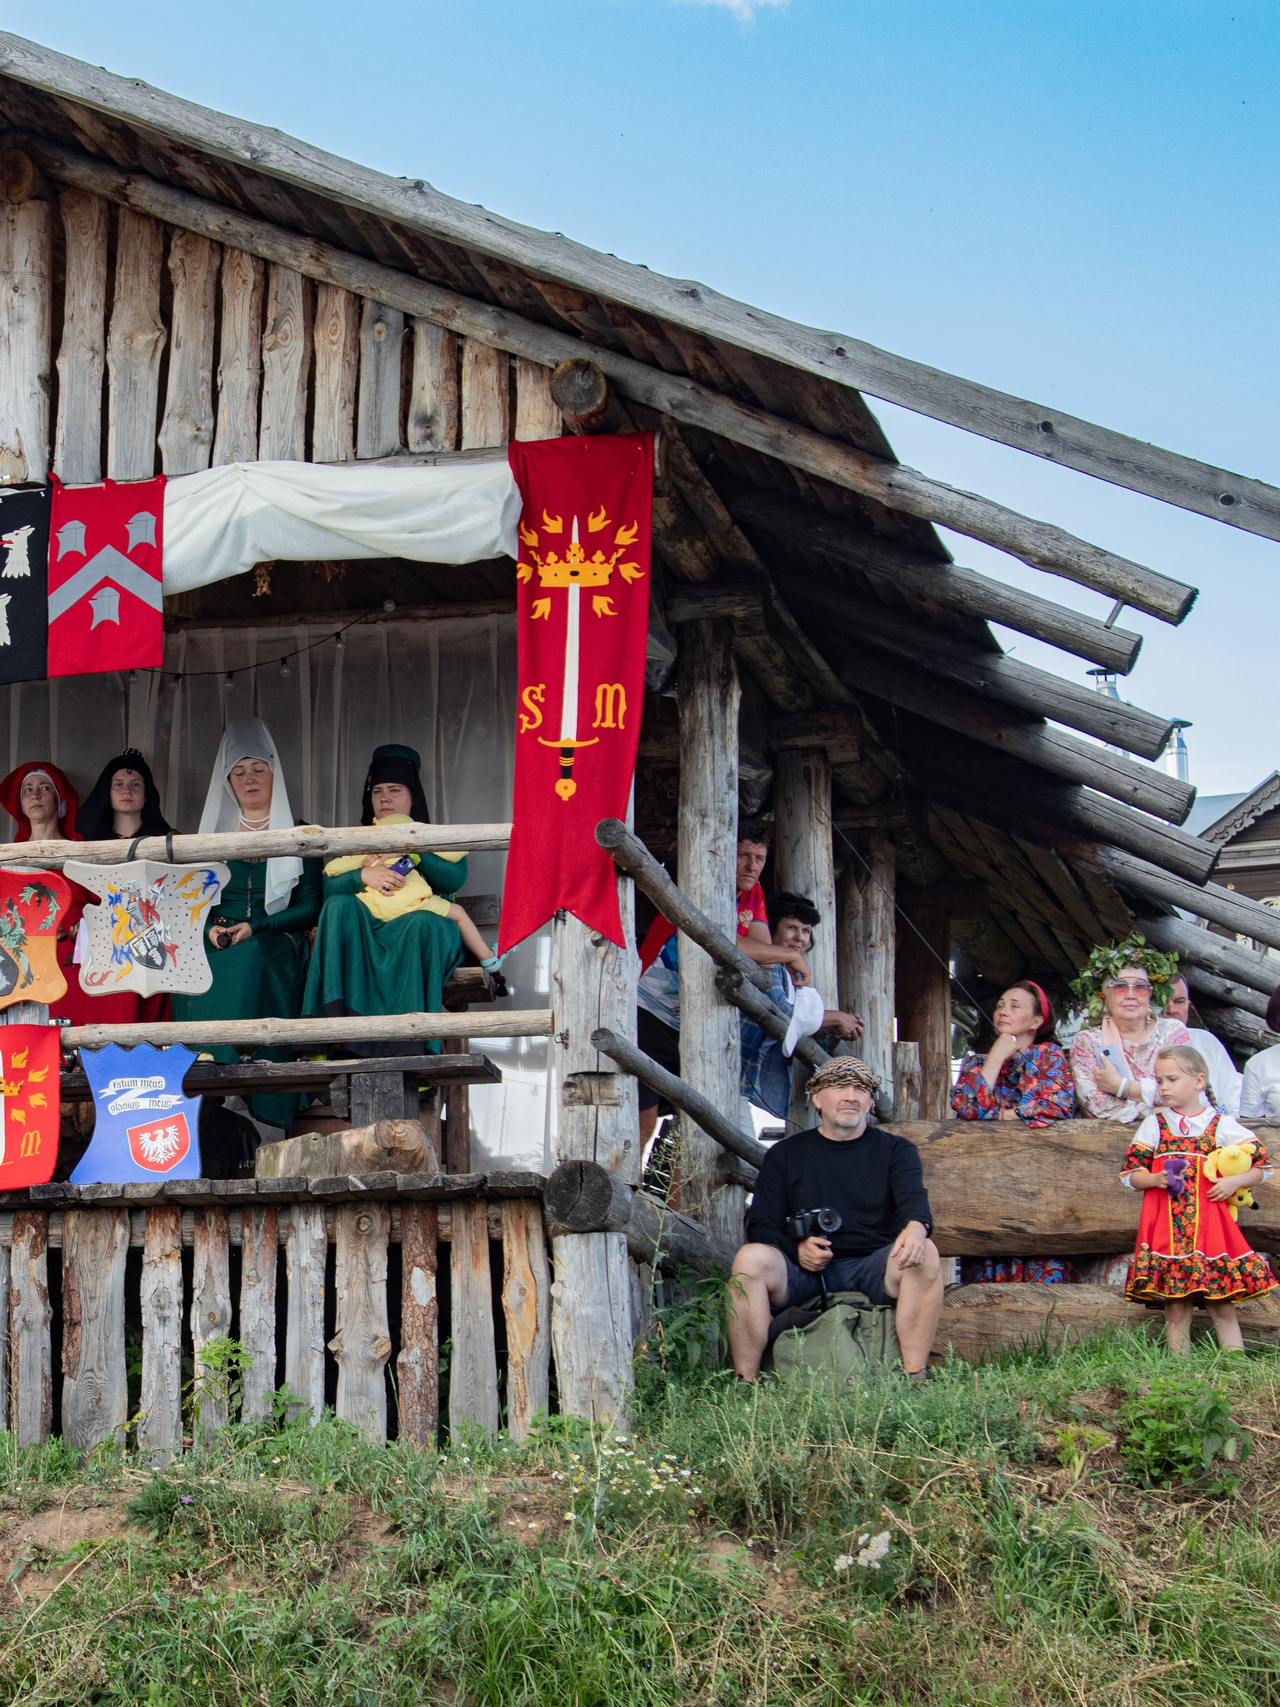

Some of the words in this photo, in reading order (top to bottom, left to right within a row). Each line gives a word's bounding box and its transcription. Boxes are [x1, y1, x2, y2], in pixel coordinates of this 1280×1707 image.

[519, 683, 546, 734] S
[592, 682, 628, 730] M
[140, 1079, 163, 1088] meus
[110, 1101, 140, 1113] gladius
[148, 1099, 172, 1108] meus
[20, 1130, 42, 1158] M
